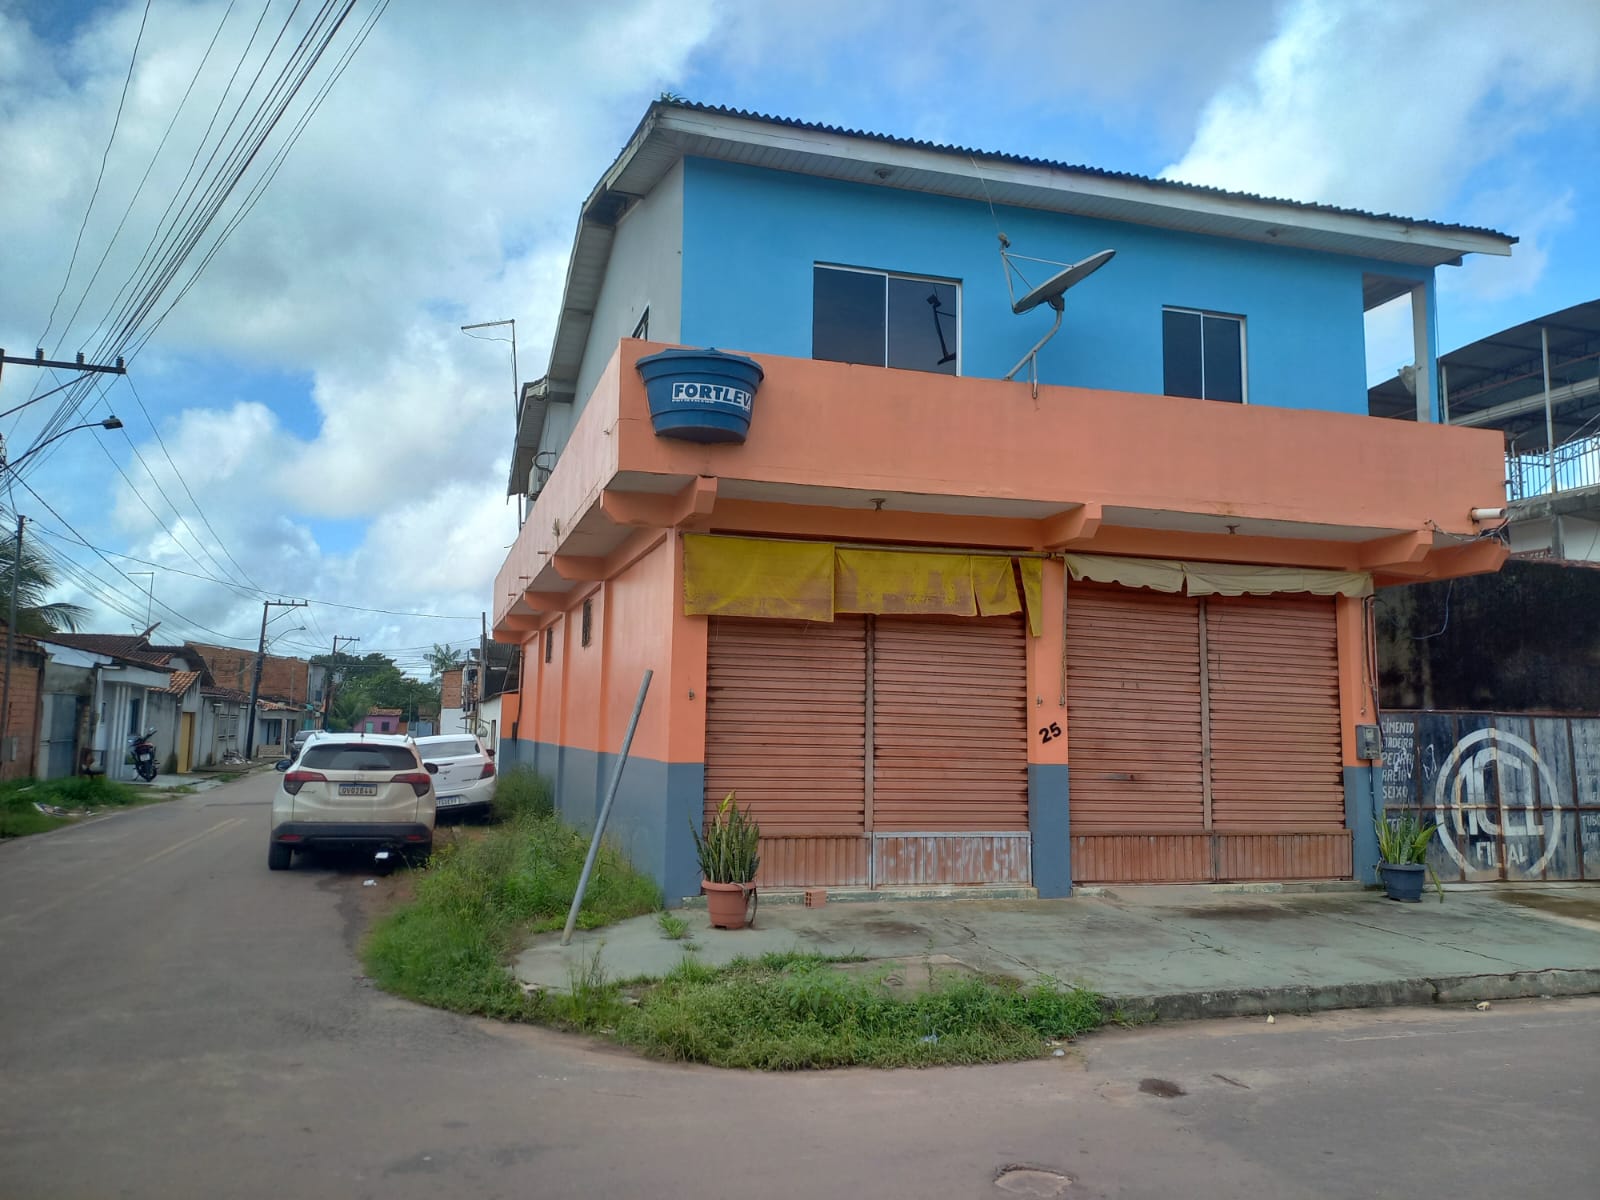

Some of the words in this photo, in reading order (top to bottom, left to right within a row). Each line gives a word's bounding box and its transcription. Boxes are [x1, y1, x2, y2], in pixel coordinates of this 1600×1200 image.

[673, 383, 751, 407] FORTLEV
[1038, 721, 1062, 745] 25
[1476, 841, 1528, 868] FILIAL
